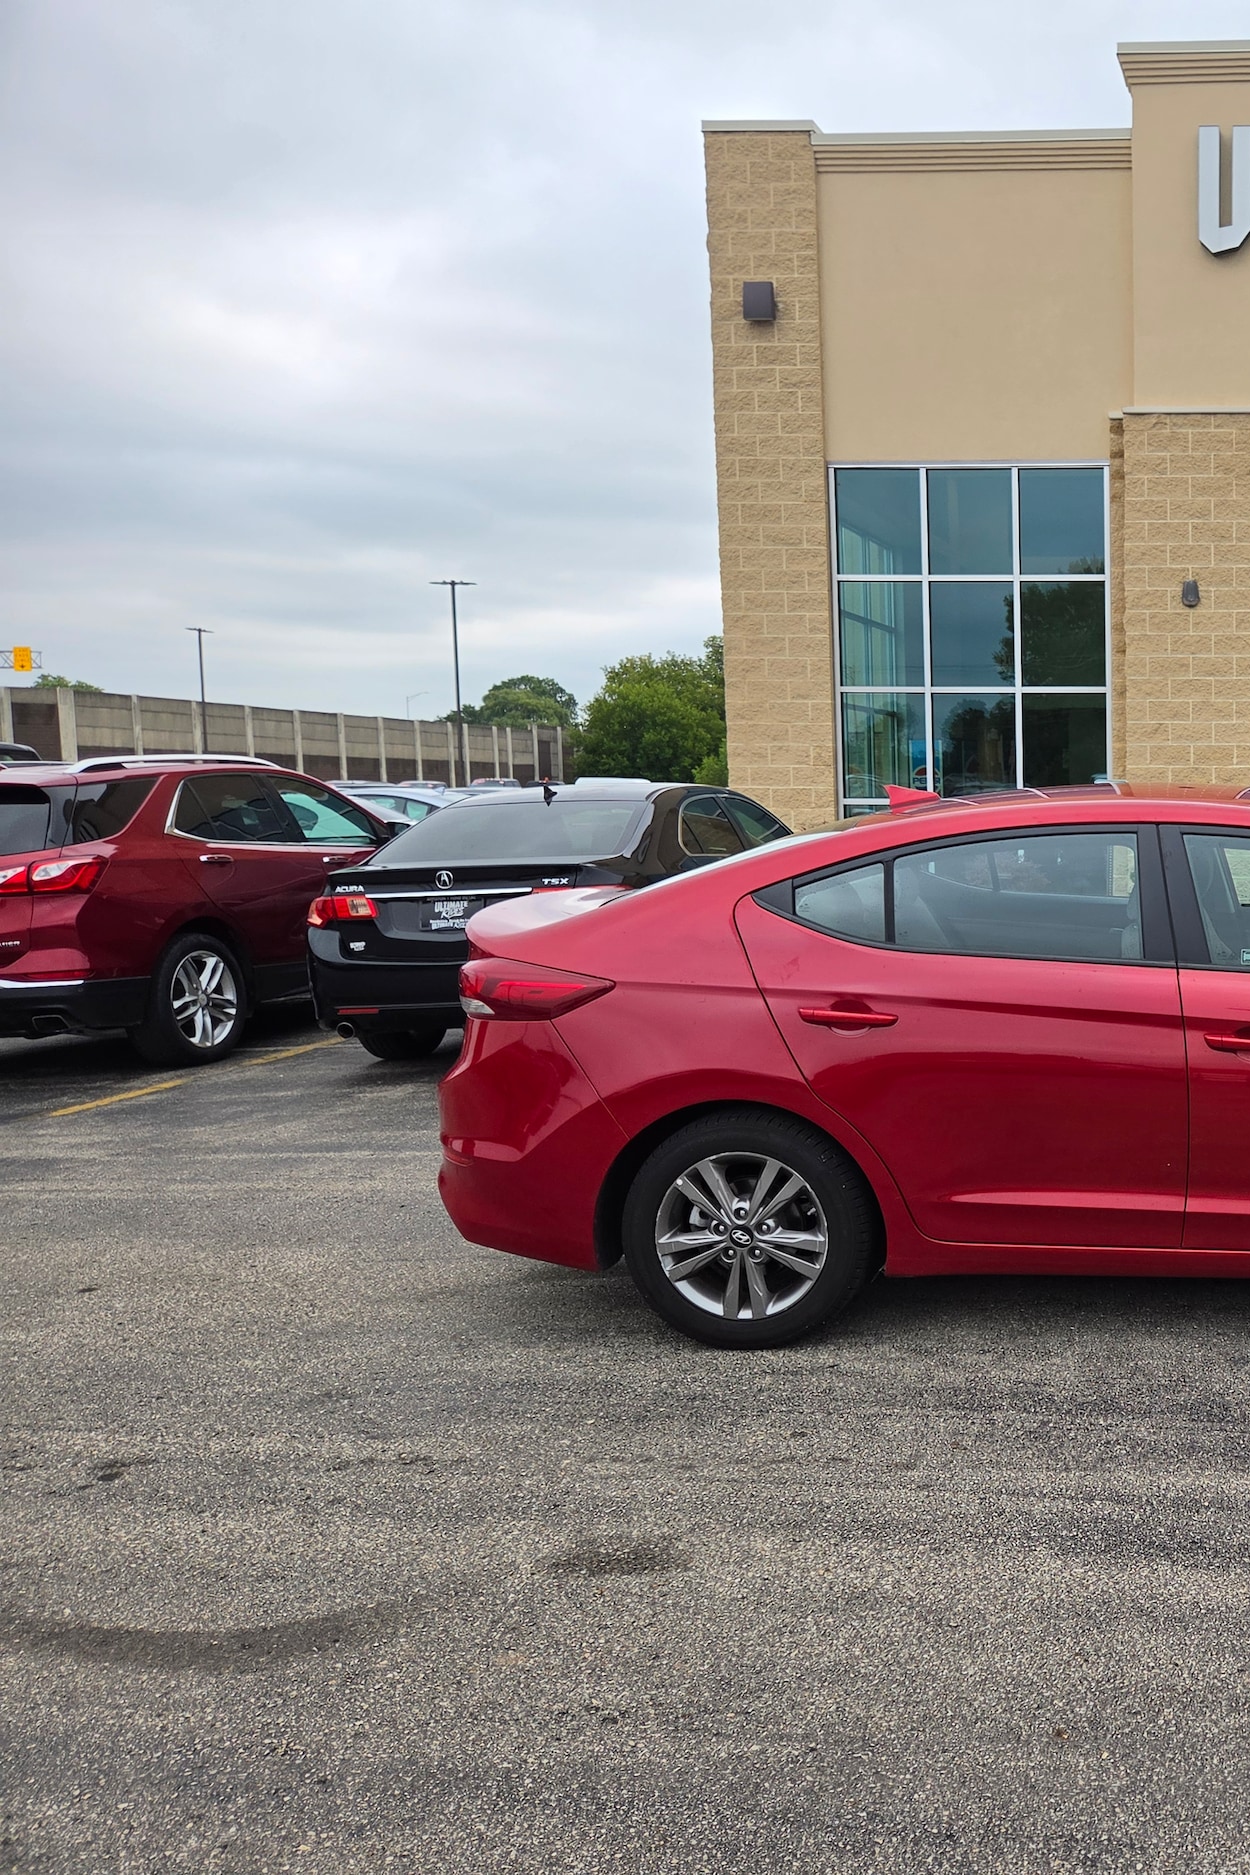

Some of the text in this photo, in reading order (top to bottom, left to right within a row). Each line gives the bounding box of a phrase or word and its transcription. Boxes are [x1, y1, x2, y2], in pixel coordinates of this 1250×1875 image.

[541, 877, 569, 885] TSX
[334, 885, 365, 893] ACURA
[434, 900, 469, 913] ULTIMATE
